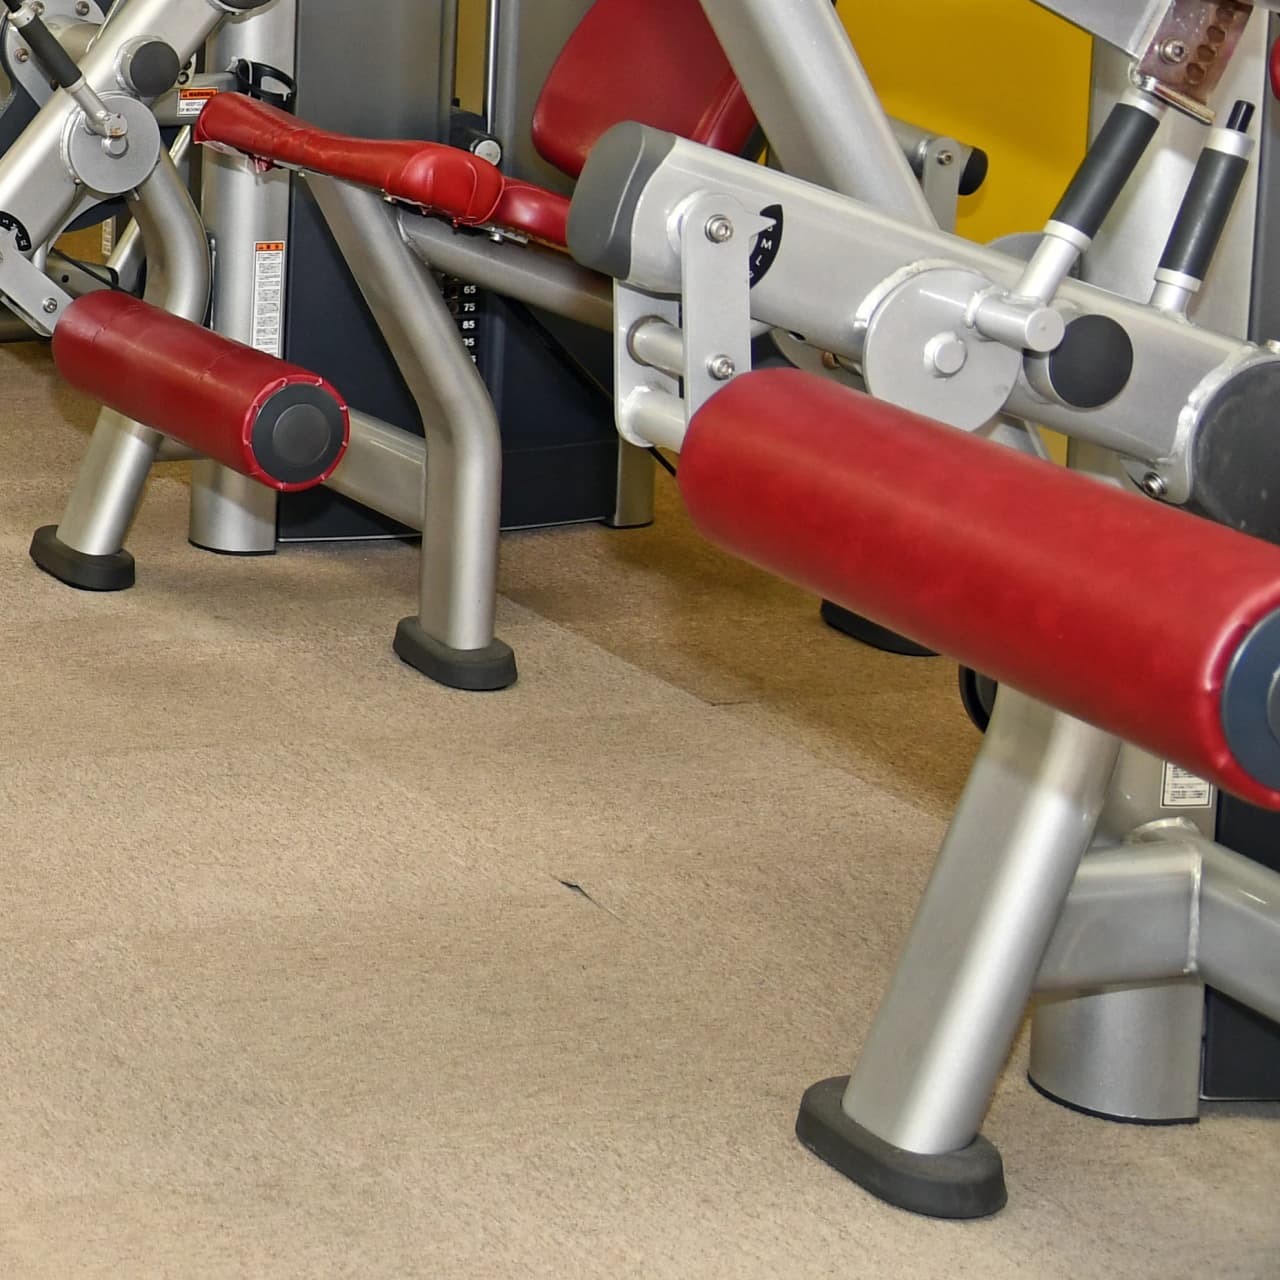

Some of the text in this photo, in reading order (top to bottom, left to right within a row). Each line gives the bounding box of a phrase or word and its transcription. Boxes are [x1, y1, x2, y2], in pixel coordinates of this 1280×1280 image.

[760, 237, 772, 251] M
[755, 254, 763, 267] L
[463, 285, 477, 294] 65
[463, 303, 476, 312] 75
[462, 320, 476, 329] 85
